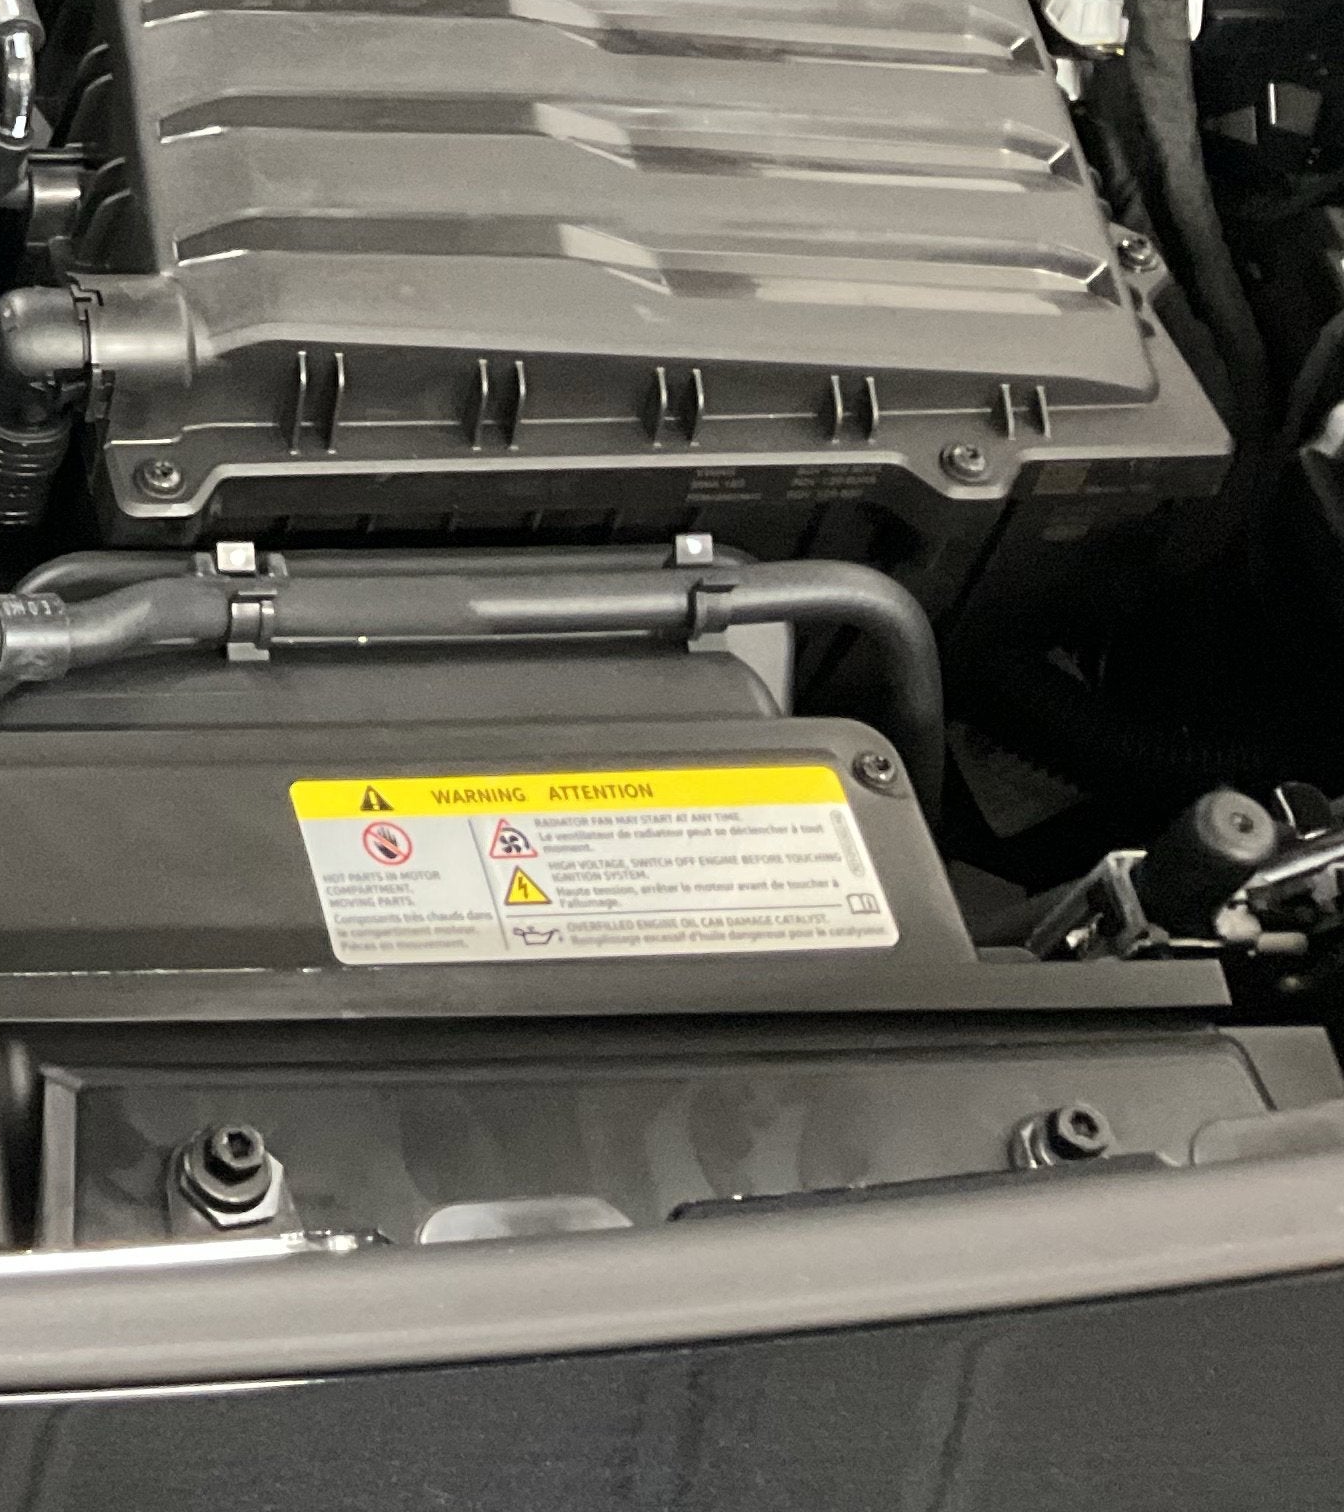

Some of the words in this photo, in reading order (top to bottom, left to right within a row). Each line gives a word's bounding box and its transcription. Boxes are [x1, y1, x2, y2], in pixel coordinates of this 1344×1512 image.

[432, 787, 526, 806] WARNING
[549, 783, 654, 801] ATTENTION
[640, 814, 673, 825] START
[548, 860, 576, 870] HIGH
[348, 872, 383, 882] PARTS
[399, 870, 440, 881] MOTOR
